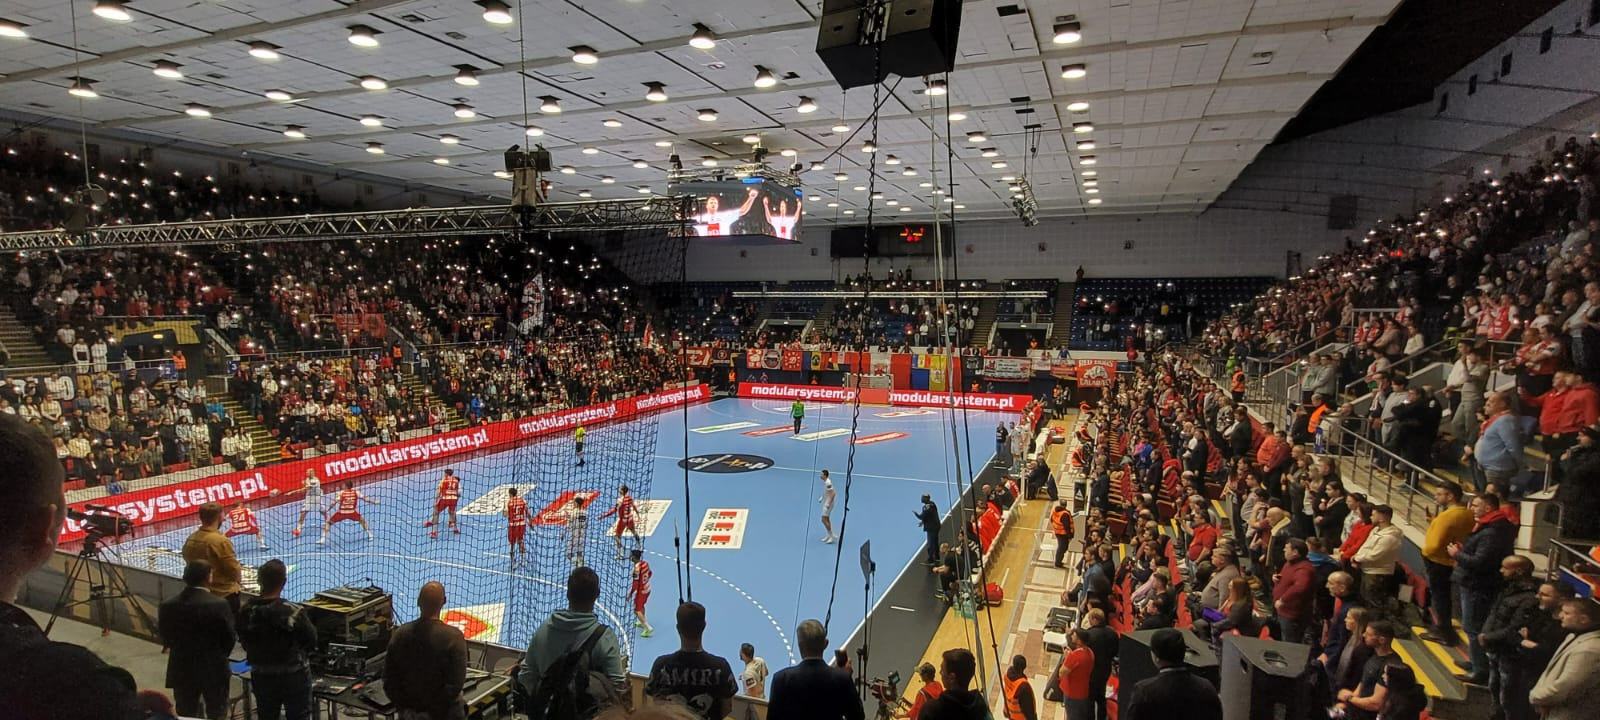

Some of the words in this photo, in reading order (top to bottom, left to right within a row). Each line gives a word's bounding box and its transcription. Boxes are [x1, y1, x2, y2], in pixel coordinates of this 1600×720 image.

[889, 392, 1014, 408] modularsystem.pl
[519, 403, 618, 434] modularsystem.pl
[324, 428, 490, 478] modularsystem.pl
[658, 665, 722, 686] AMIRI
